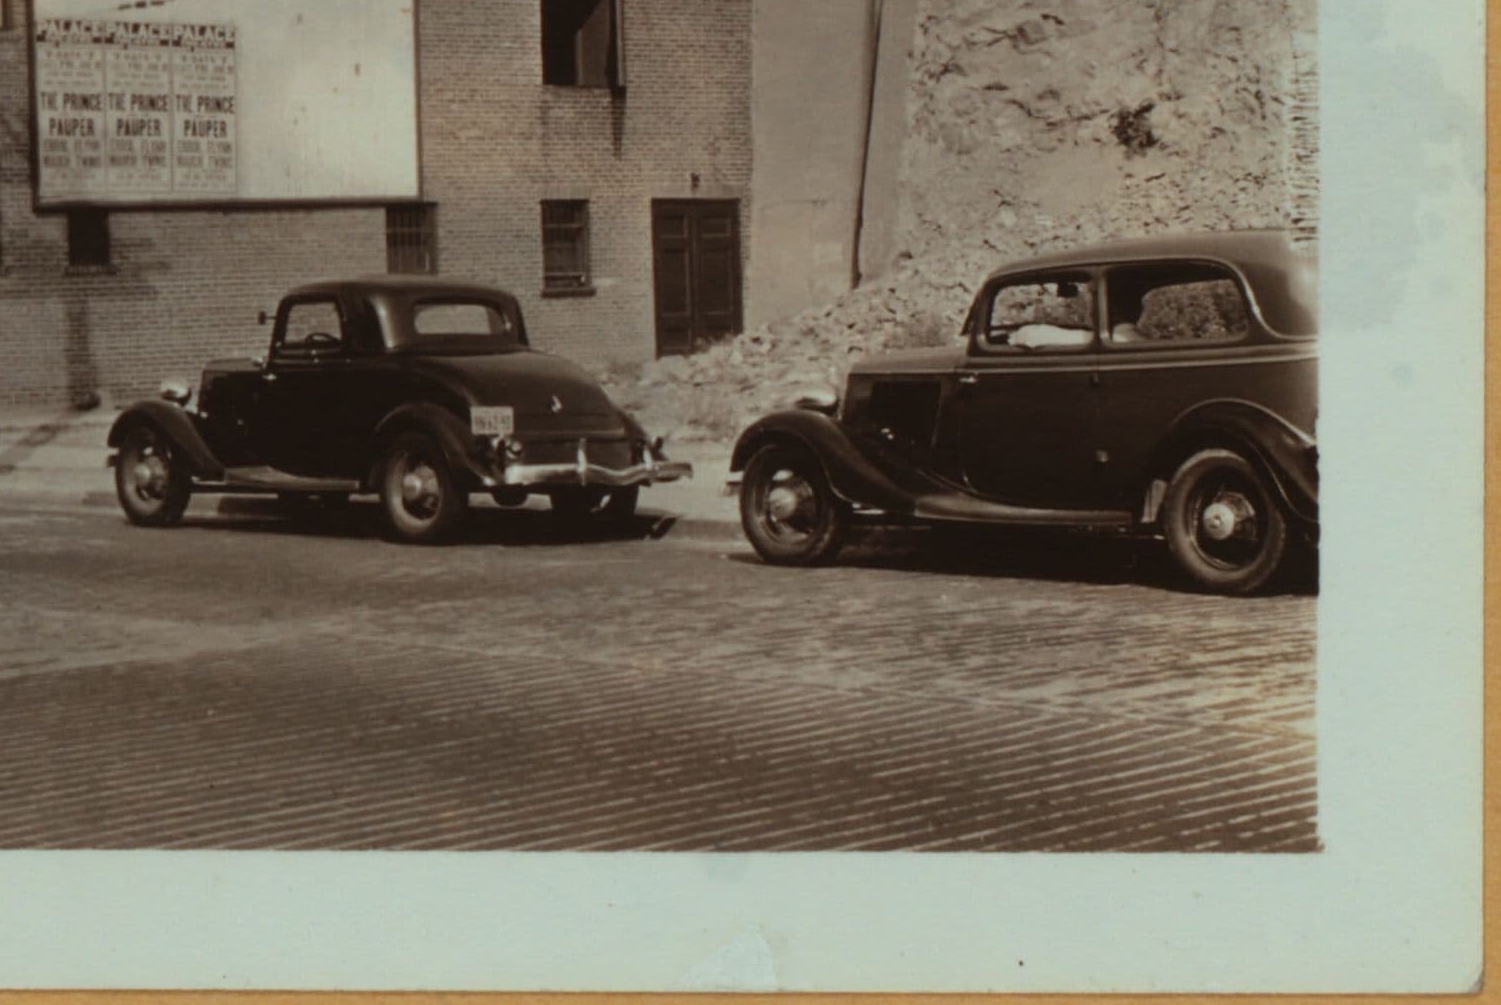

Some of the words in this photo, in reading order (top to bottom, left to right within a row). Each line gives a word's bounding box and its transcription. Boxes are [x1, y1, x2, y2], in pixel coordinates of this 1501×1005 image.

[36, 20, 103, 37] PALACE
[105, 22, 170, 38] PALACE
[173, 23, 236, 40] PALACE
[41, 92, 58, 111] THE
[63, 92, 102, 111] PRINCE
[108, 92, 125, 111] THE
[131, 93, 169, 112] PRINCE
[176, 94, 193, 113] THE
[197, 95, 235, 114] PRINCE
[49, 118, 95, 136] PAUPER
[116, 118, 161, 136] PAUPER
[184, 120, 227, 138] PAUPER
